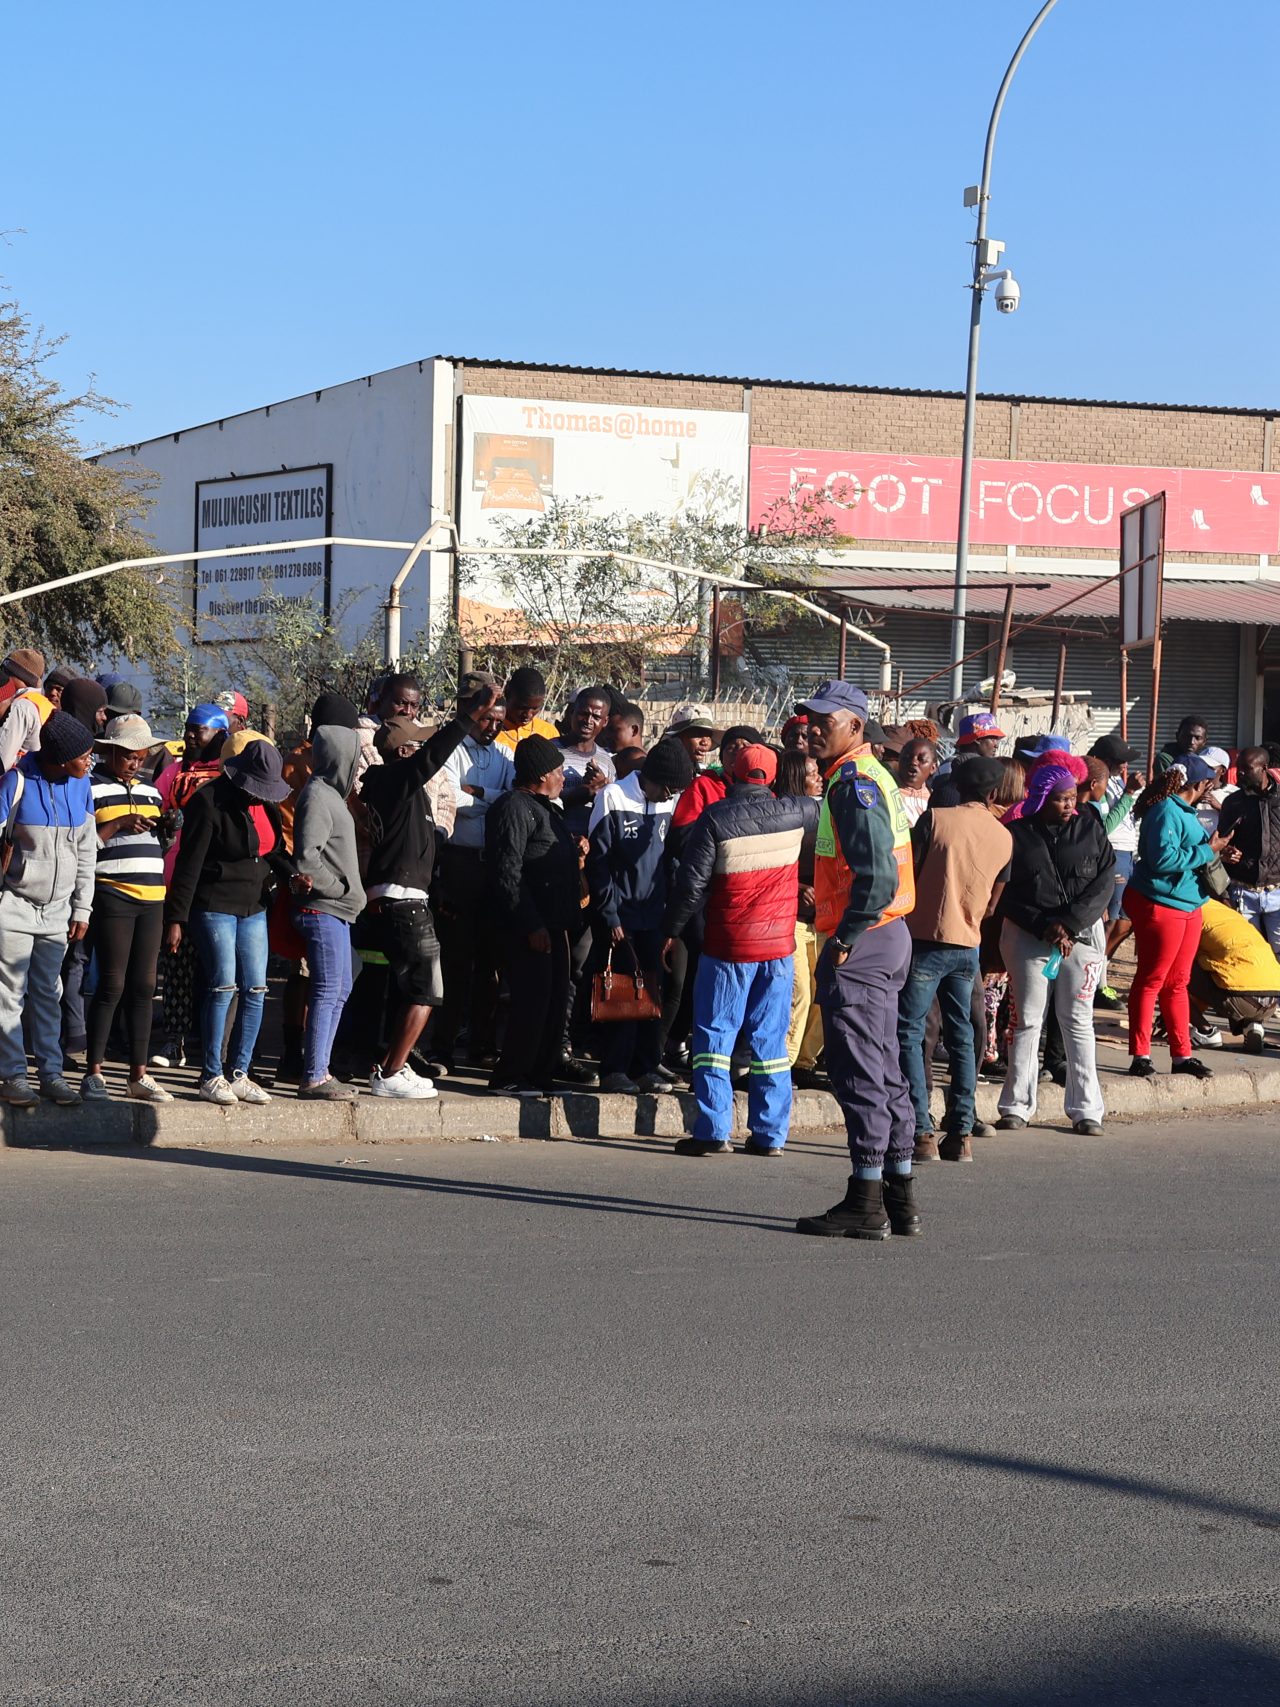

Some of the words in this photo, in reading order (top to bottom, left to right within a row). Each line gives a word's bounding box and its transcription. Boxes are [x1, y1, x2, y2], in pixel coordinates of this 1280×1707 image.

[521, 406, 697, 439] Thomas@home
[202, 492, 271, 528] MULUNGUSHI
[274, 486, 324, 521] TEXTILES
[789, 467, 943, 516] FOOT
[245, 598, 258, 615] the
[624, 826, 638, 839] 25
